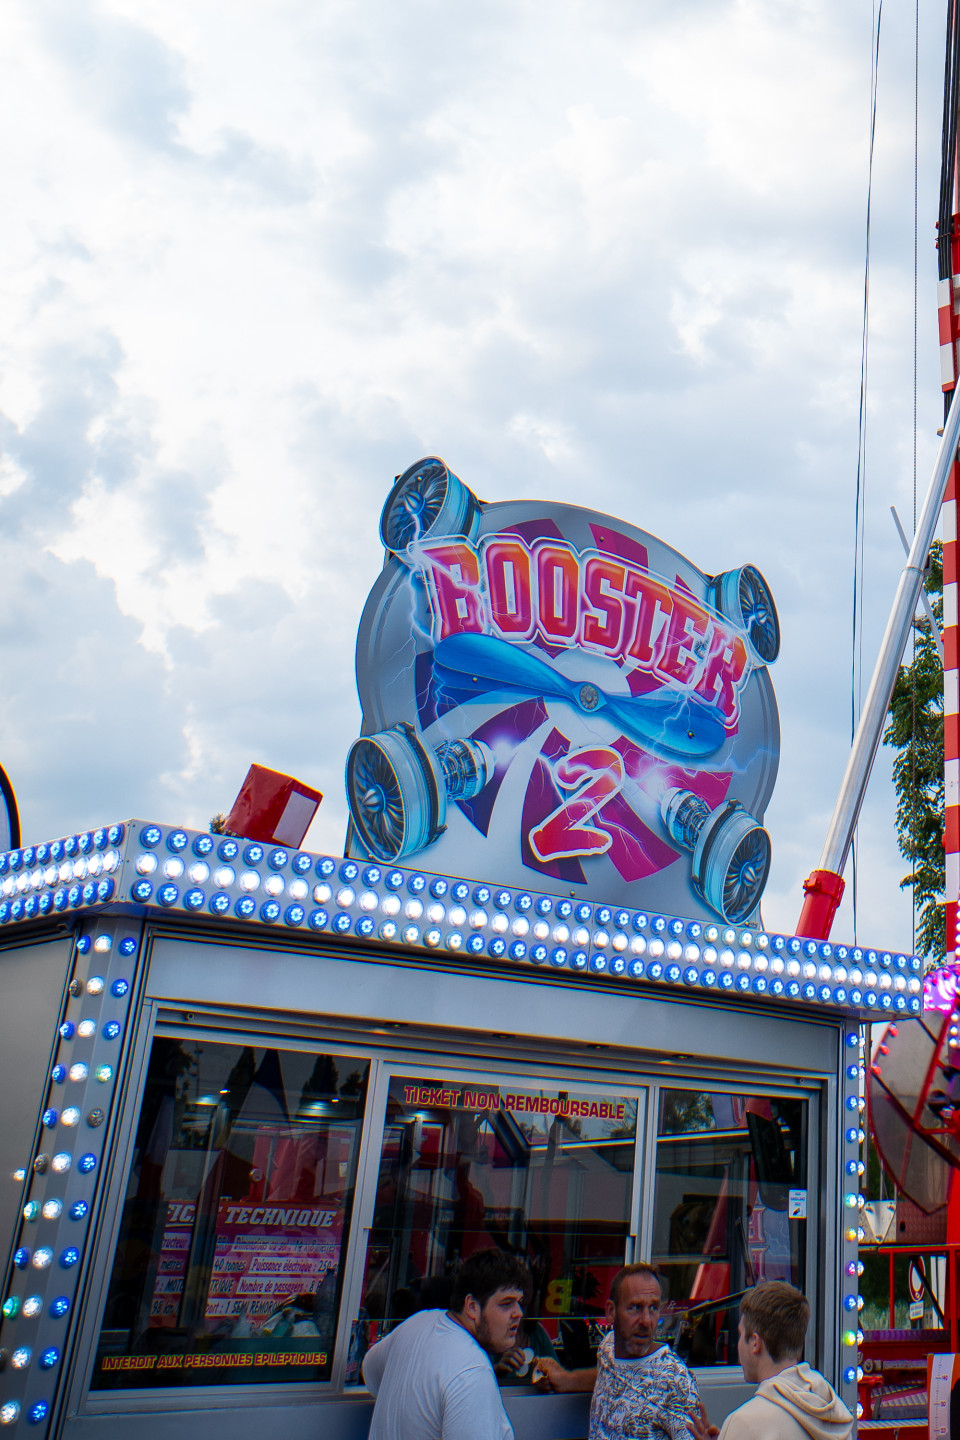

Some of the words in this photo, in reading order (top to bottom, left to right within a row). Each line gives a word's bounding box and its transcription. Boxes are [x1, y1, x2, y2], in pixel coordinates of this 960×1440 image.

[414, 537, 751, 724] BOOSTER
[529, 744, 625, 862] 2
[404, 1085, 460, 1106] TICKET
[464, 1090, 500, 1110] NON
[505, 1094, 625, 1120] REMBOURSABLE
[225, 1206, 337, 1229] TECHNIQUE
[101, 1355, 157, 1370] INTERDIT
[157, 1354, 184, 1369] AUX
[184, 1353, 253, 1368] PERSONNES
[253, 1351, 328, 1367] EPILEPTIQUES
